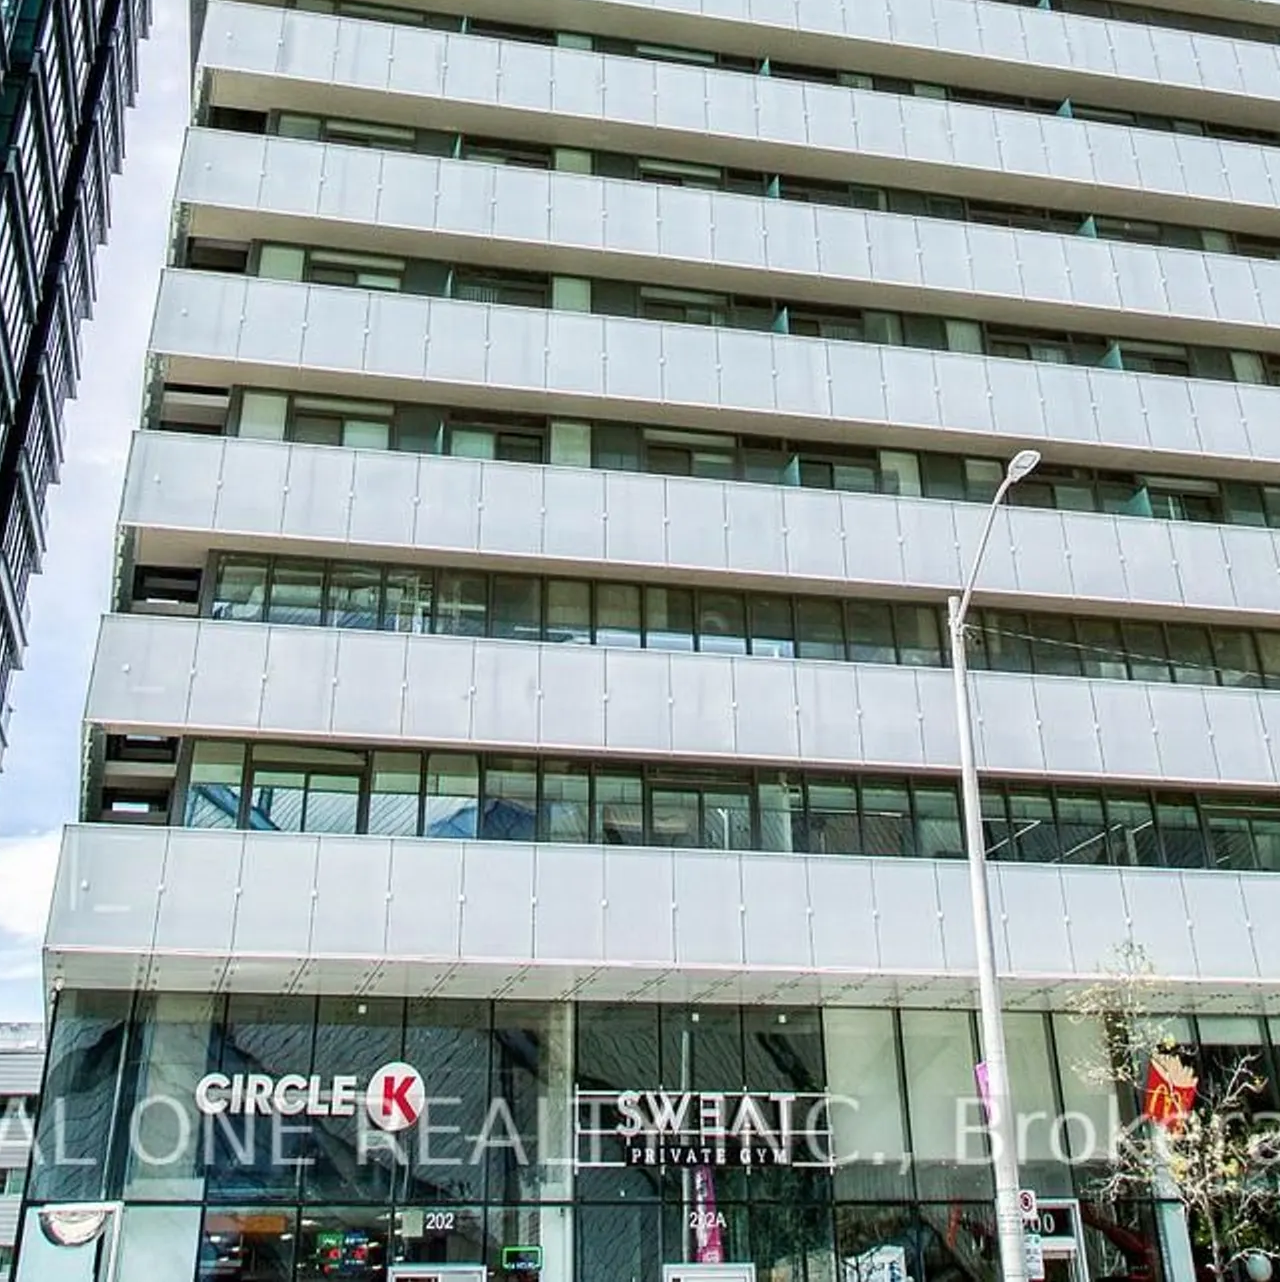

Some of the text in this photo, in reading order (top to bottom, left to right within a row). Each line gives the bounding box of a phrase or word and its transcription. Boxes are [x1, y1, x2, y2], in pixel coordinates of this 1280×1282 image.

[195, 1073, 418, 1125] CIRCLE K
[616, 1090, 796, 1137] SWEAT
[631, 1147, 788, 1165] PRIVATE GYM
[425, 1212, 455, 1230] 202
